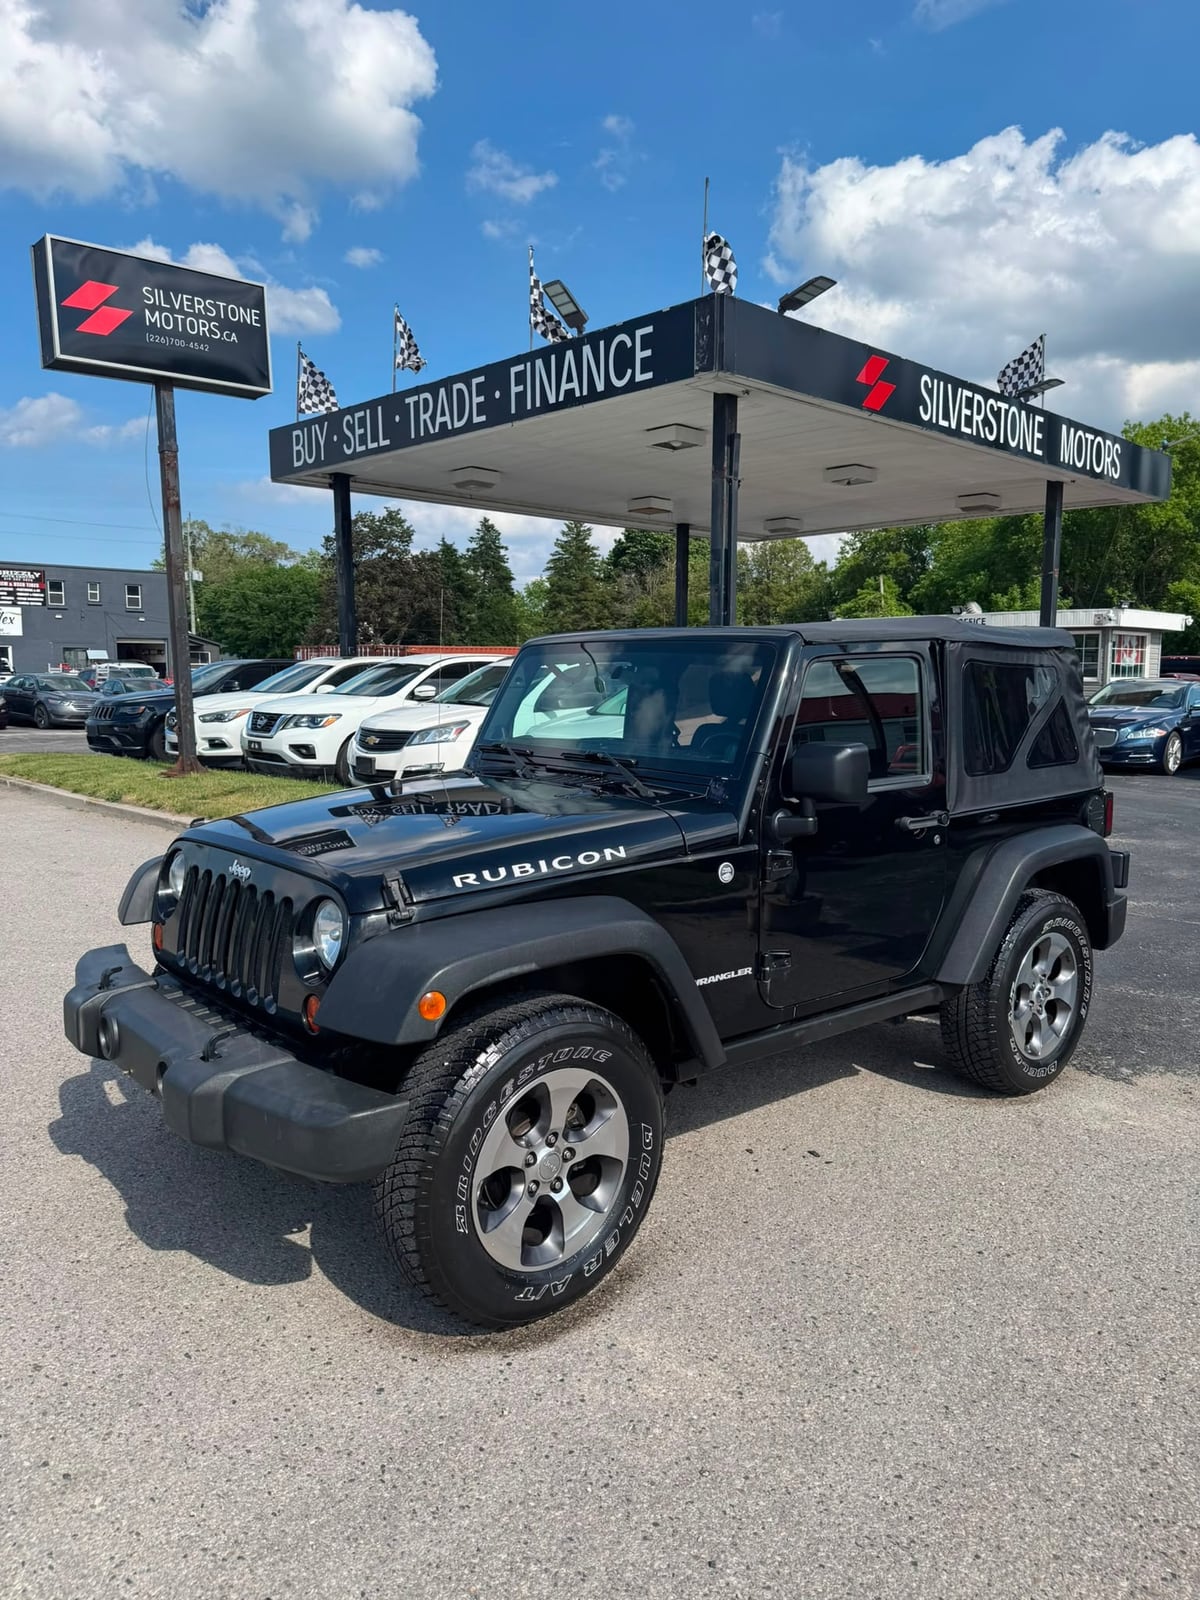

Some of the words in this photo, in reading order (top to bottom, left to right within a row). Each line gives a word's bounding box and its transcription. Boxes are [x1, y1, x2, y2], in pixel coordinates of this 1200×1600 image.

[142, 286, 261, 327] SILVERSTONE
[144, 308, 238, 343] MOTORS.CA
[145, 332, 210, 352] (226)700-4542
[292, 421, 328, 468] BUY
[342, 405, 390, 455] SELL
[404, 375, 486, 439] TRADE
[509, 325, 654, 414] FINANCE
[918, 374, 1045, 457] SILVERSTONE
[1060, 424, 1122, 480] MOTORS
[228, 859, 252, 882] Jeep
[452, 846, 627, 888] RUBICON
[455, 1045, 614, 1235] BRIDGESTONE
[583, 1123, 653, 1279] DUELER
[514, 1274, 572, 1301] A/T
